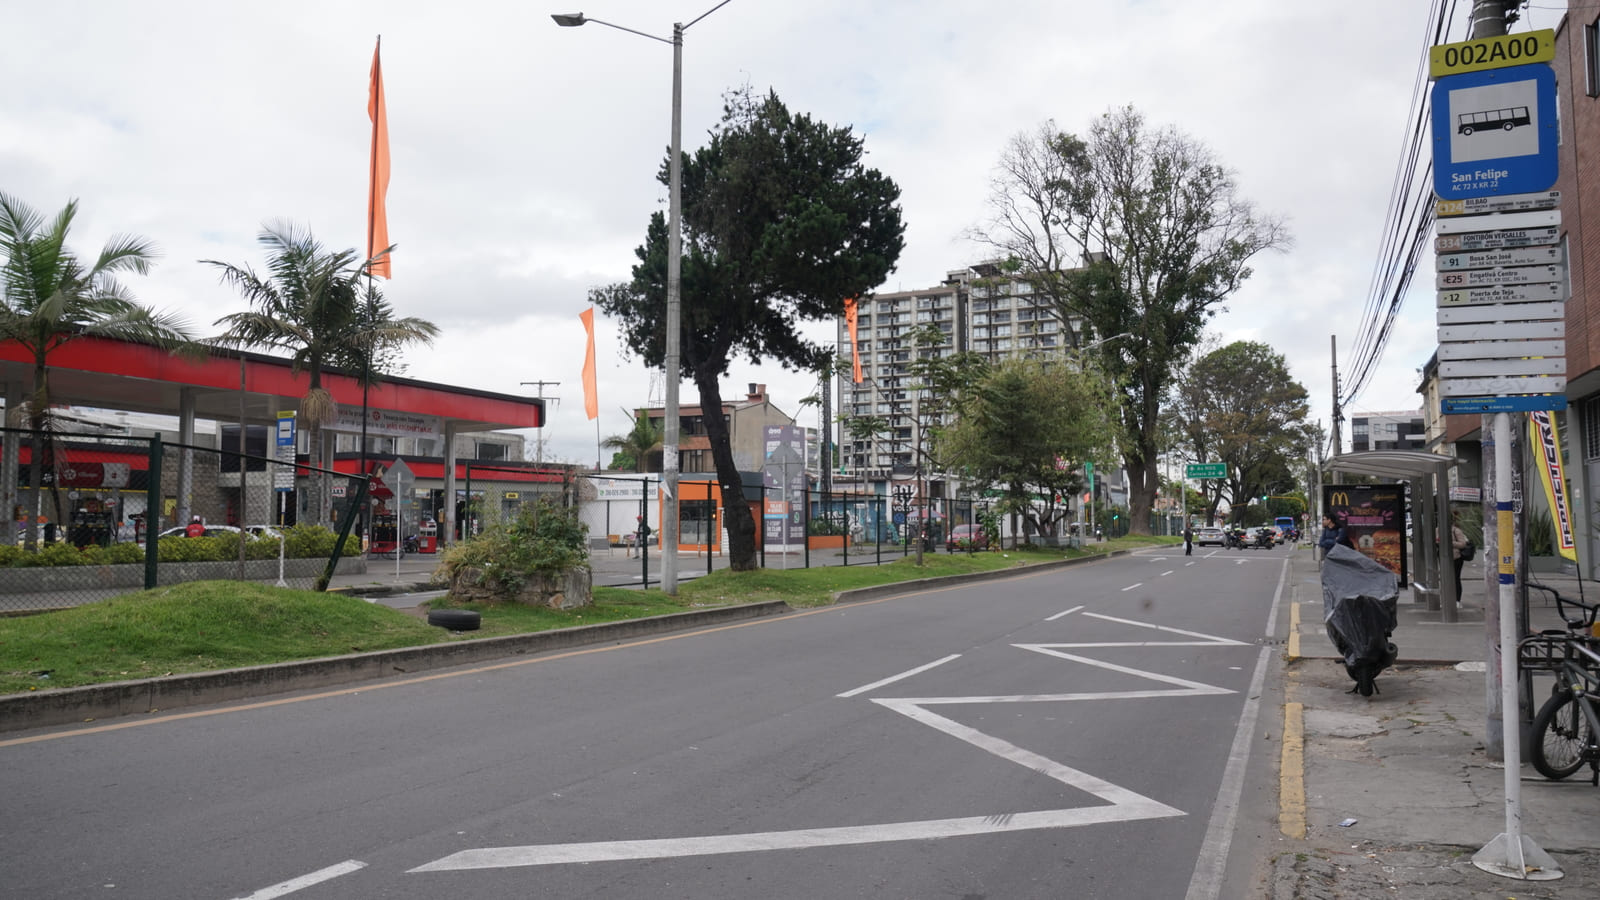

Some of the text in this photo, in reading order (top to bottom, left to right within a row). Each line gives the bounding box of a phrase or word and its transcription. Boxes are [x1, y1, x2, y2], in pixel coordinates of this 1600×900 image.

[1445, 36, 1538, 67] 002A00
[1452, 169, 1508, 183] San Felipe
[1452, 183, 1461, 191] AC
[1463, 182, 1471, 190] 72
[1495, 231, 1527, 239] VERSALLES
[1449, 258, 1459, 266] 91
[1446, 275, 1463, 284] E25
[1449, 293, 1460, 302] 12
